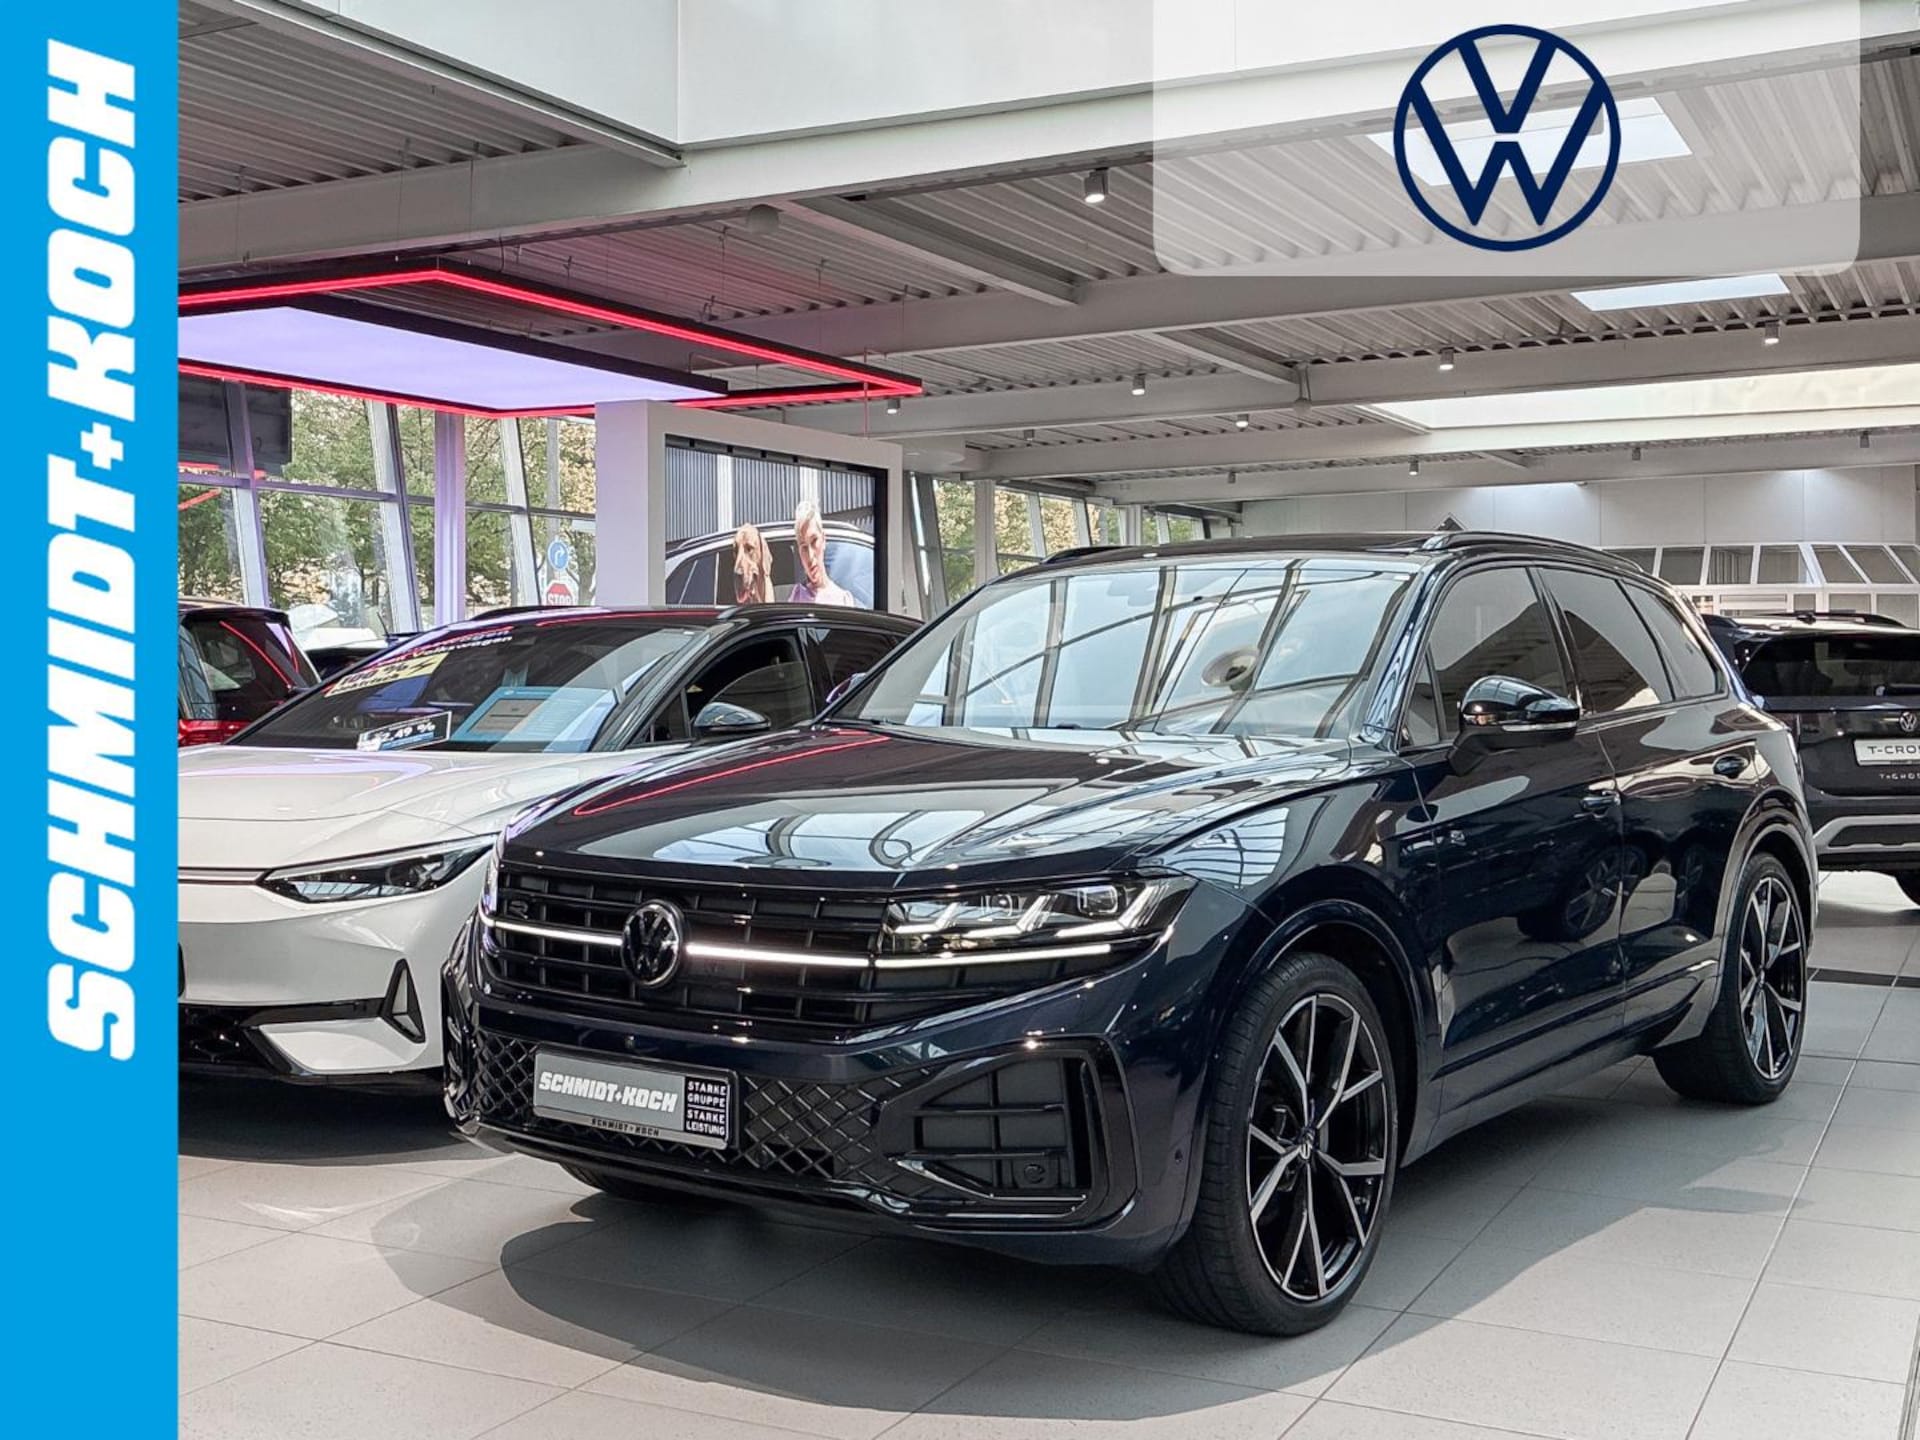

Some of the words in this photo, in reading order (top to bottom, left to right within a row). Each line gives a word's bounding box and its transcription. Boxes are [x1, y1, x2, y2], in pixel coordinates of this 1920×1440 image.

[1867, 745, 1920, 754] T-CRO
[538, 1071, 679, 1113] SCHMIDT+KOCH
[687, 1080, 727, 1097] STARKE
[687, 1092, 726, 1108] GRUPPE
[686, 1109, 726, 1124] STARKE
[685, 1121, 726, 1137] LEISTUNG
